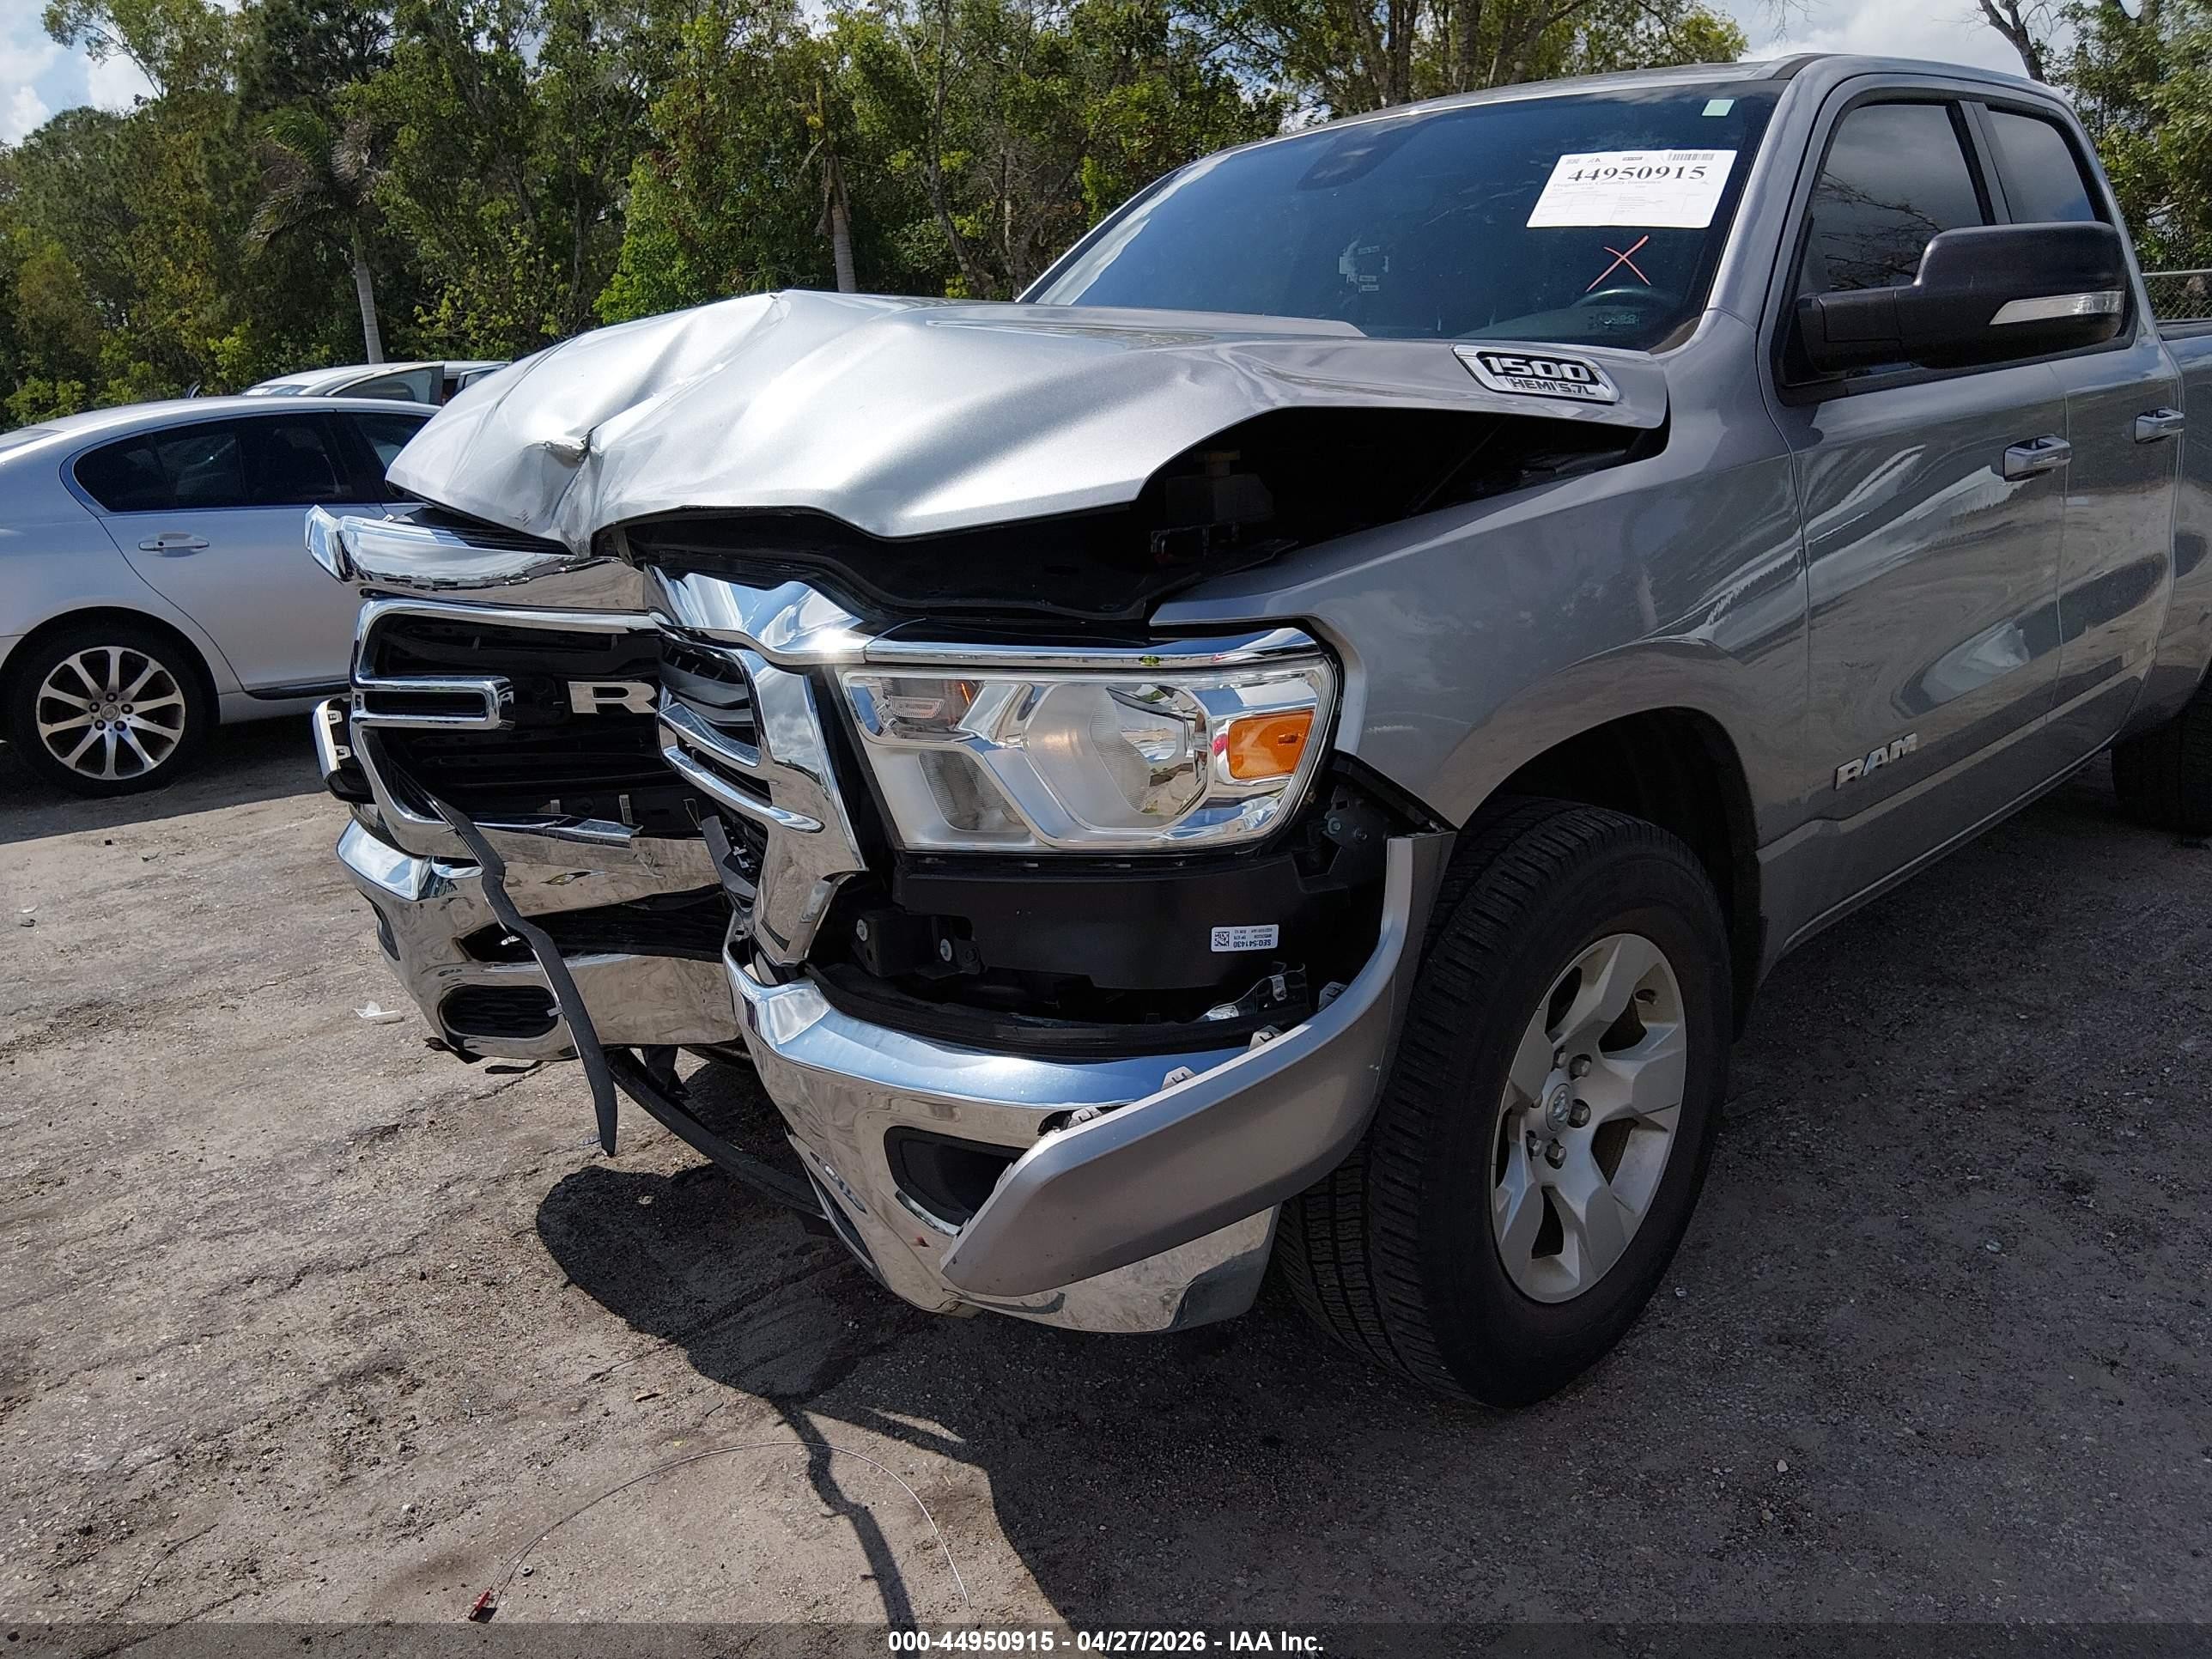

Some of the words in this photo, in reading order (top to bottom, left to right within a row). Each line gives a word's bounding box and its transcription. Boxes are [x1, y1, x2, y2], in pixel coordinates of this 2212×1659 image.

[1567, 166, 1708, 182] 44950915
[1484, 356, 1591, 381] 1500
[1510, 377, 1557, 391] HEMI
[1559, 383, 1595, 396] 5.7L
[568, 681, 658, 714] R
[1834, 732, 1917, 790] RAM
